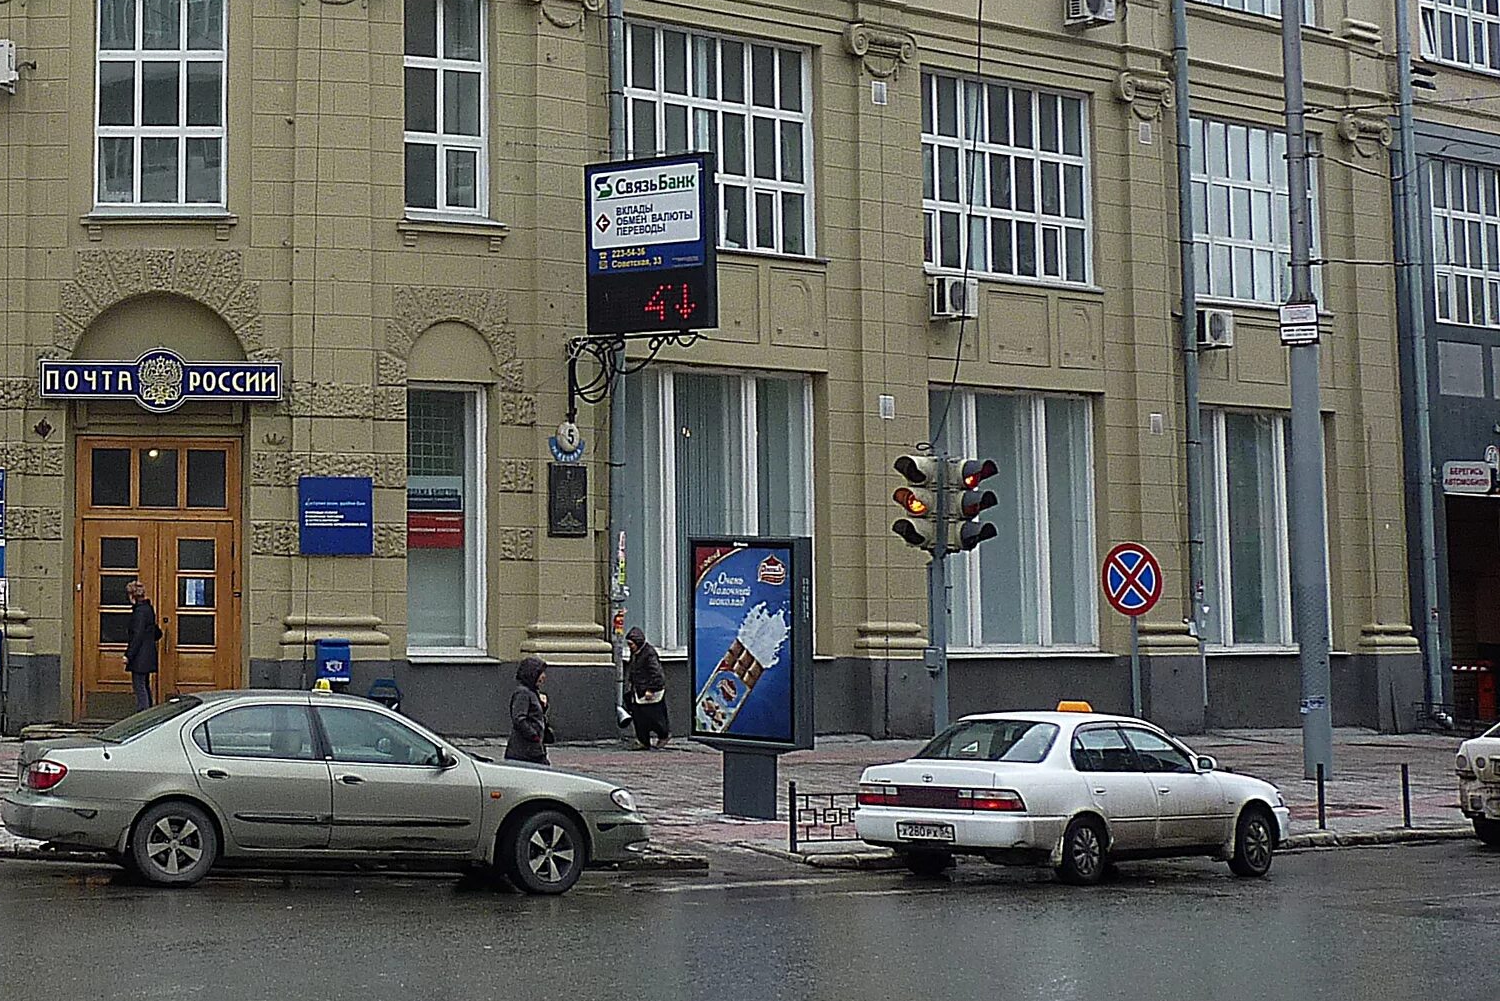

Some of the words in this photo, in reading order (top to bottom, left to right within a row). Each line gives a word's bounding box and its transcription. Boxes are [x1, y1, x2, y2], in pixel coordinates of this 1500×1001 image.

[616, 204, 653, 216] ВКЛАДЫ
[616, 215, 647, 226] ОБМЕН
[651, 210, 693, 222] ВАЛЮТЫ
[616, 223, 665, 236] ПЕРЕВОДЫ
[46, 370, 132, 391] ПОЧТА
[189, 371, 276, 392] РОССИИ
[567, 429, 574, 445] 5
